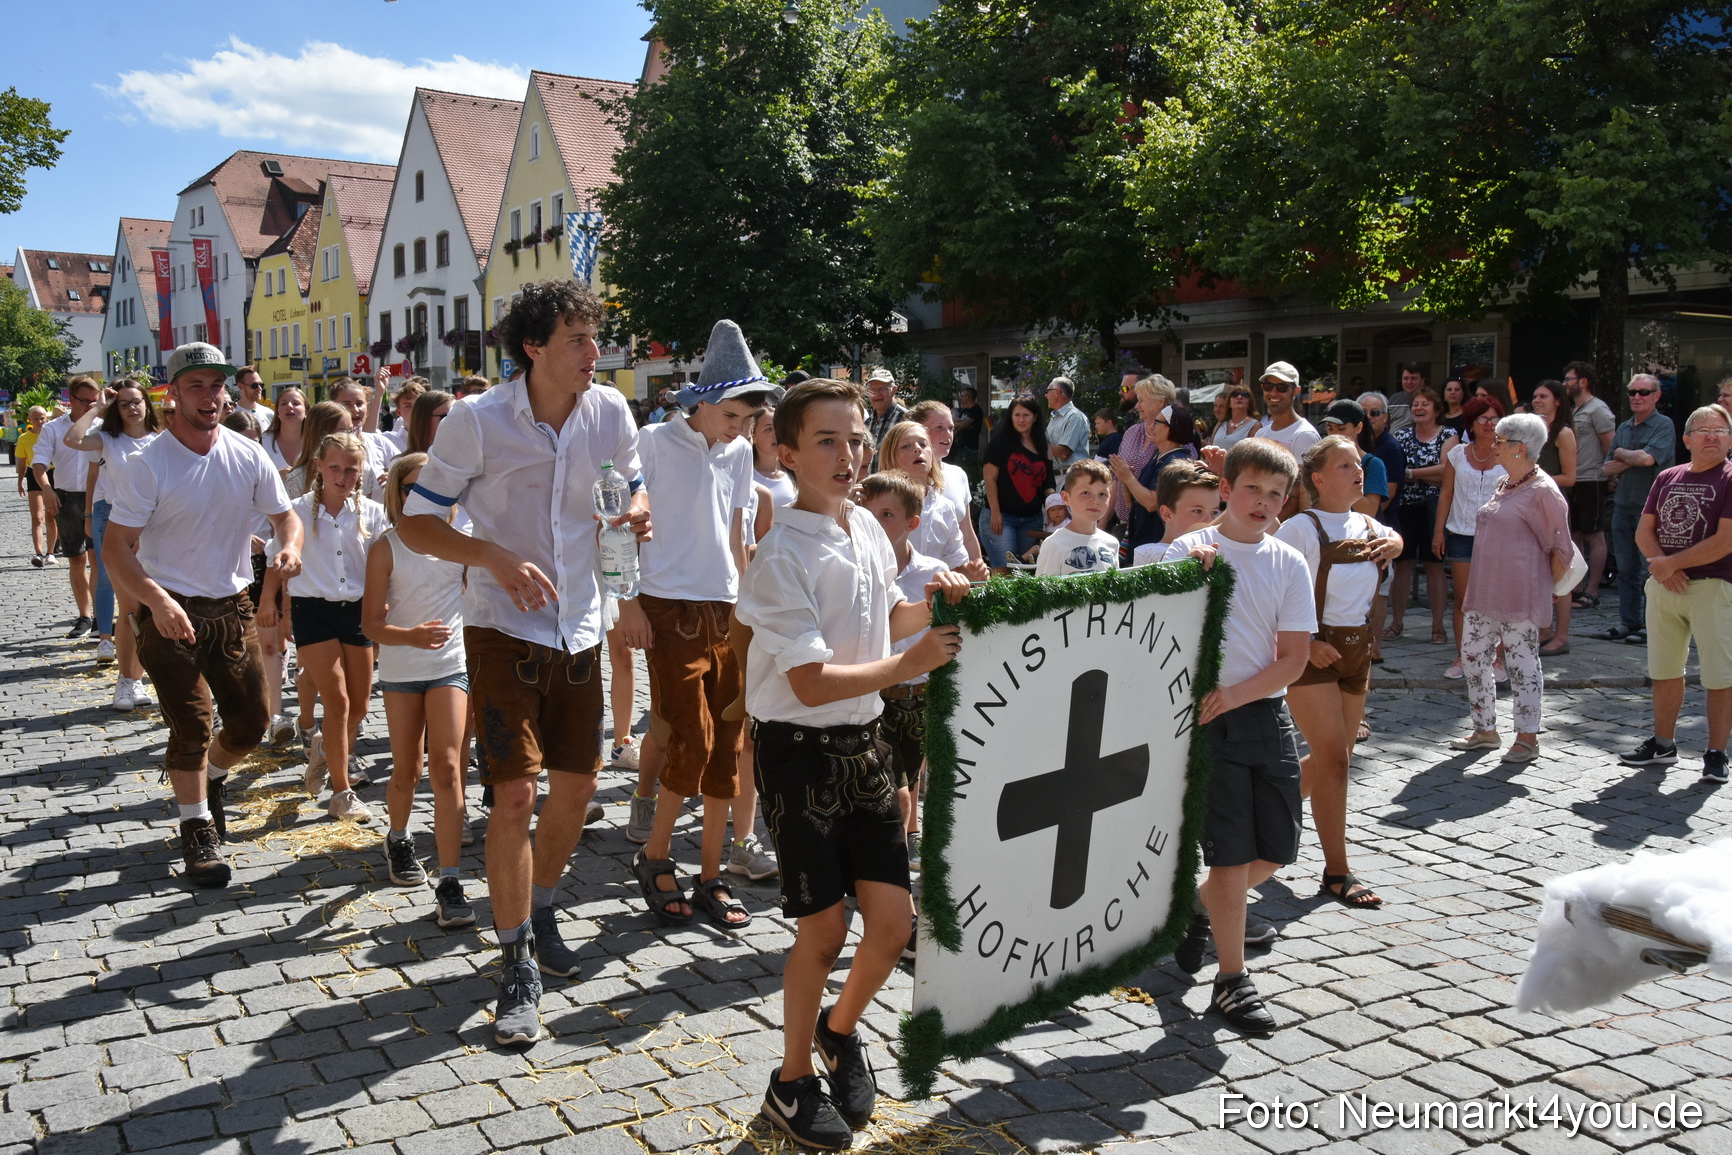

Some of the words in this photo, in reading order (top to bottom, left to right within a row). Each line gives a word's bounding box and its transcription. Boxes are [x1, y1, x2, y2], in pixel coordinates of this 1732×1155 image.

[196, 243, 207, 268] K&L
[273, 309, 287, 322] HOTEL
[273, 371, 293, 381] Restaurant
[504, 361, 511, 377] P
[954, 602, 1195, 799] MINISTRANTEN
[957, 824, 1169, 980] HOFKIRCHE
